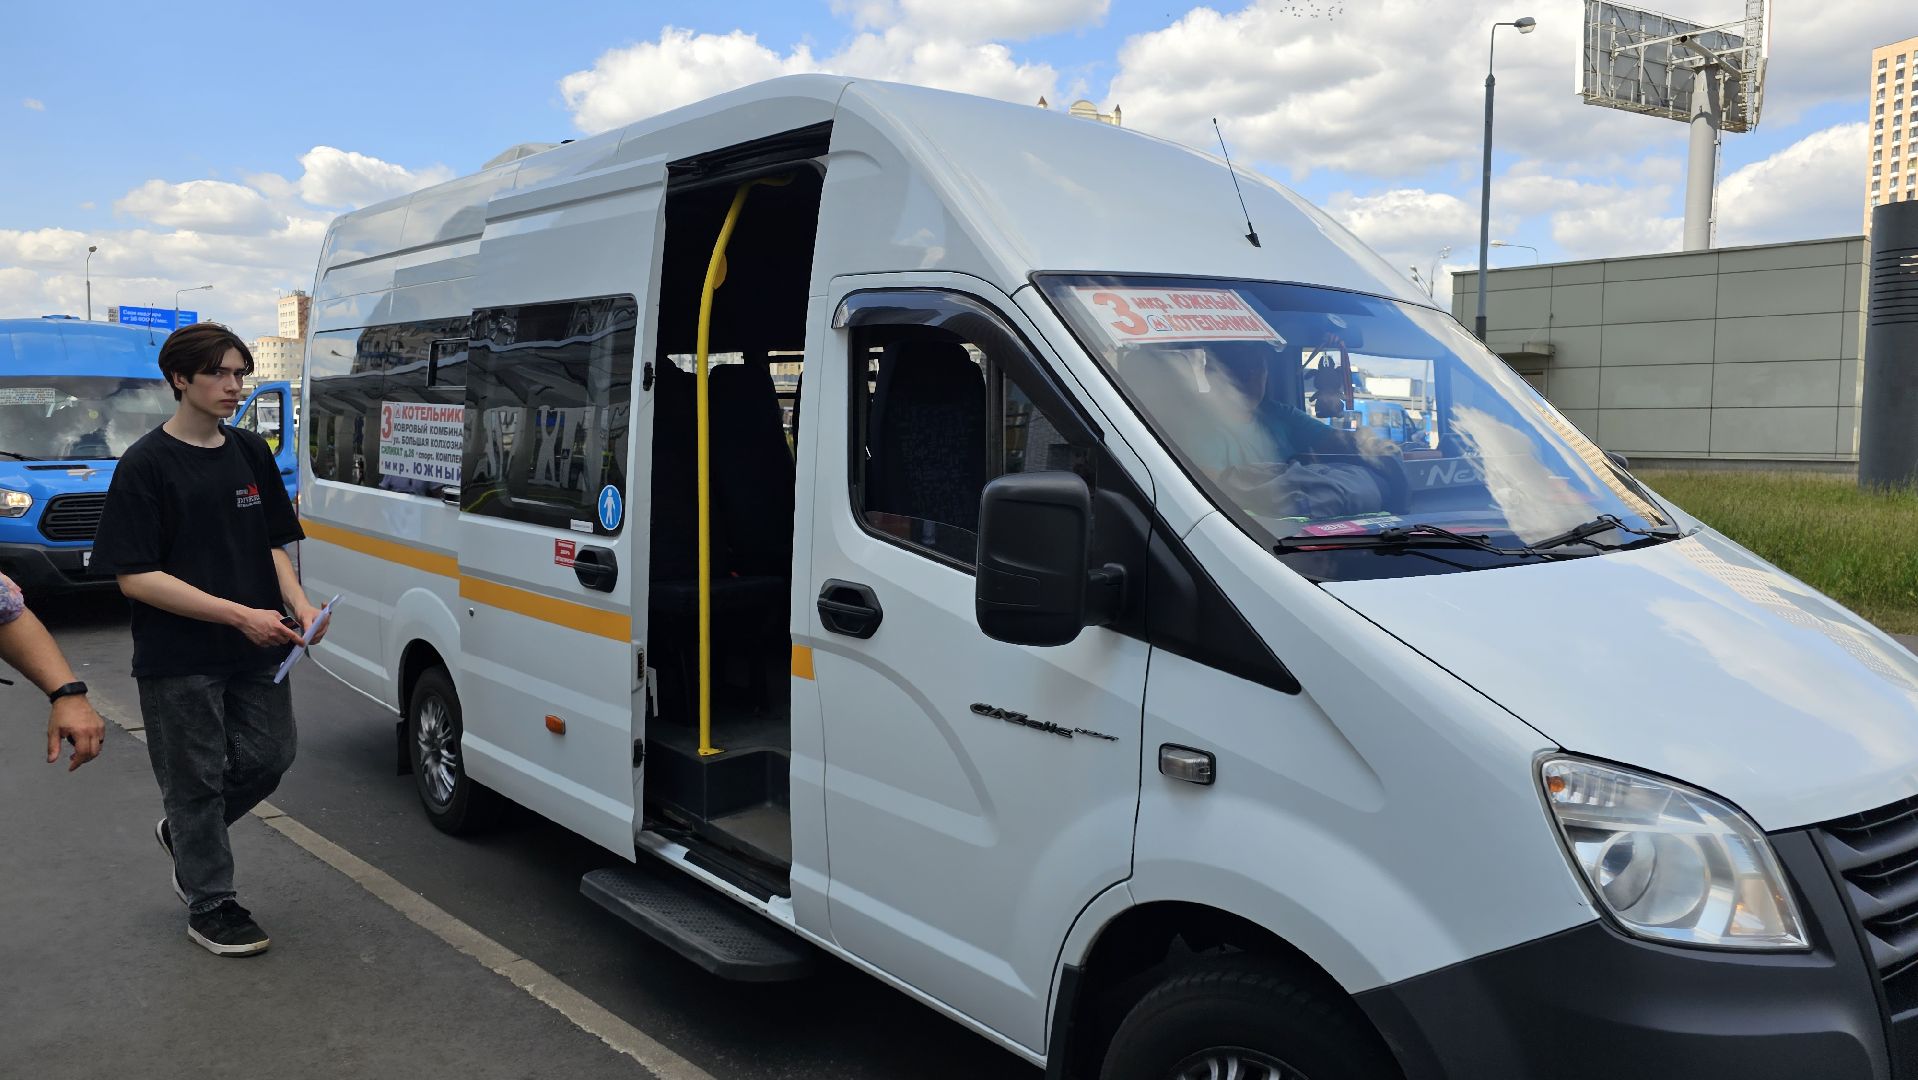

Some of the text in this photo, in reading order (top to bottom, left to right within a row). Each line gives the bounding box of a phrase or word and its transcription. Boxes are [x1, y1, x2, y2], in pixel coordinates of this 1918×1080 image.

[1167, 292, 1244, 311] ЮЖНЫЙ
[1092, 292, 1149, 336] 3
[1164, 314, 1265, 332] КОТЕЛЬНИКИ
[382, 406, 392, 438] 3
[394, 423, 428, 433] КОВРОВЫЙ
[402, 436, 429, 446] БОЛЬШАЯ
[384, 460, 409, 475] мкр.
